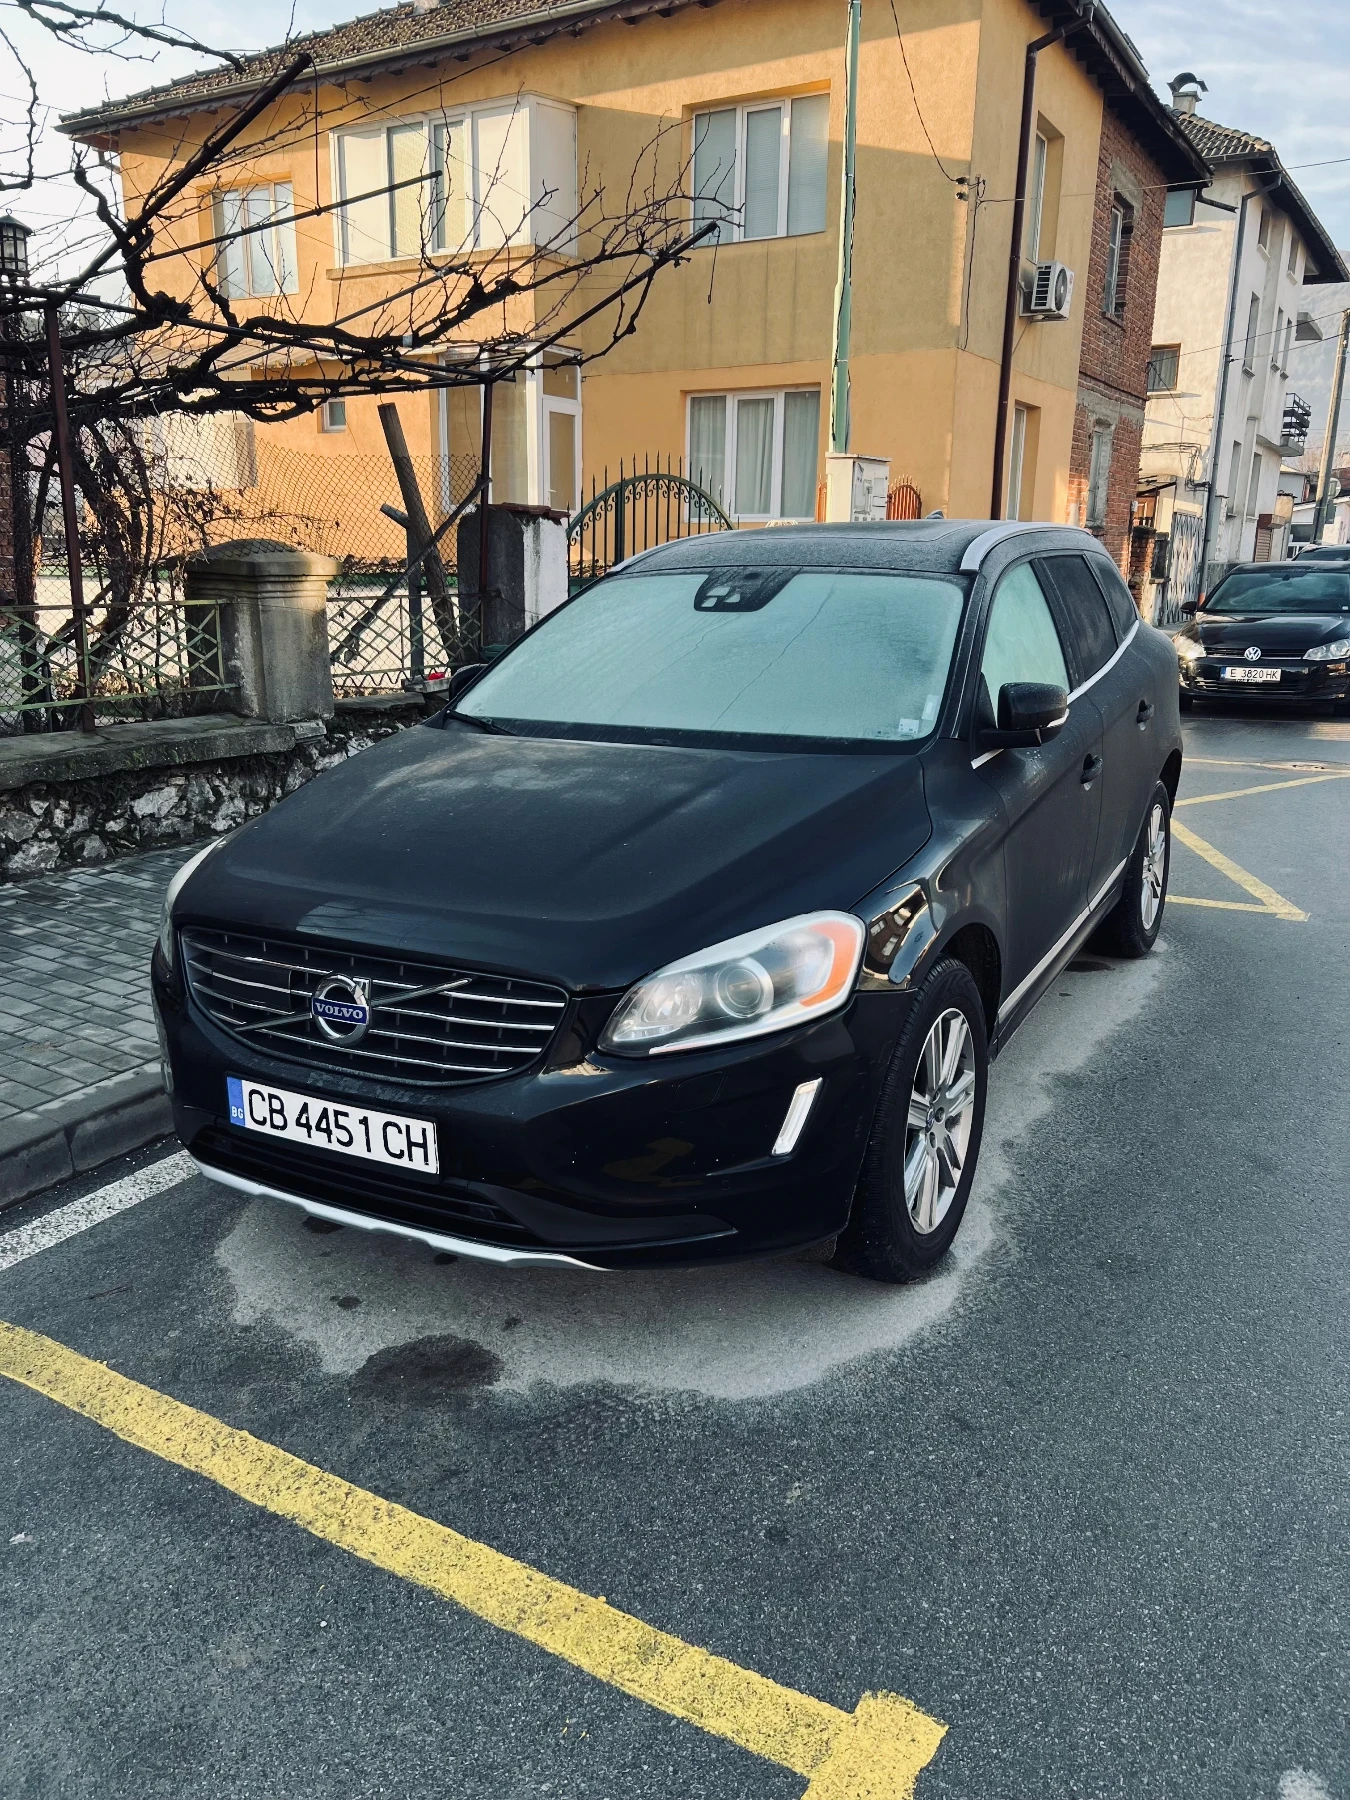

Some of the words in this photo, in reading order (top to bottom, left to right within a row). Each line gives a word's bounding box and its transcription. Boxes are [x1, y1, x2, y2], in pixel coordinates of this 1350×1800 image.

[1230, 669, 1236, 677] E
[1241, 669, 1263, 678] 3820
[1266, 670, 1277, 679] HK
[314, 1002, 364, 1019] VOLVO
[231, 1105, 244, 1119] BG
[248, 1088, 288, 1131] CB
[295, 1101, 372, 1153] 4451
[382, 1120, 430, 1166] CH
